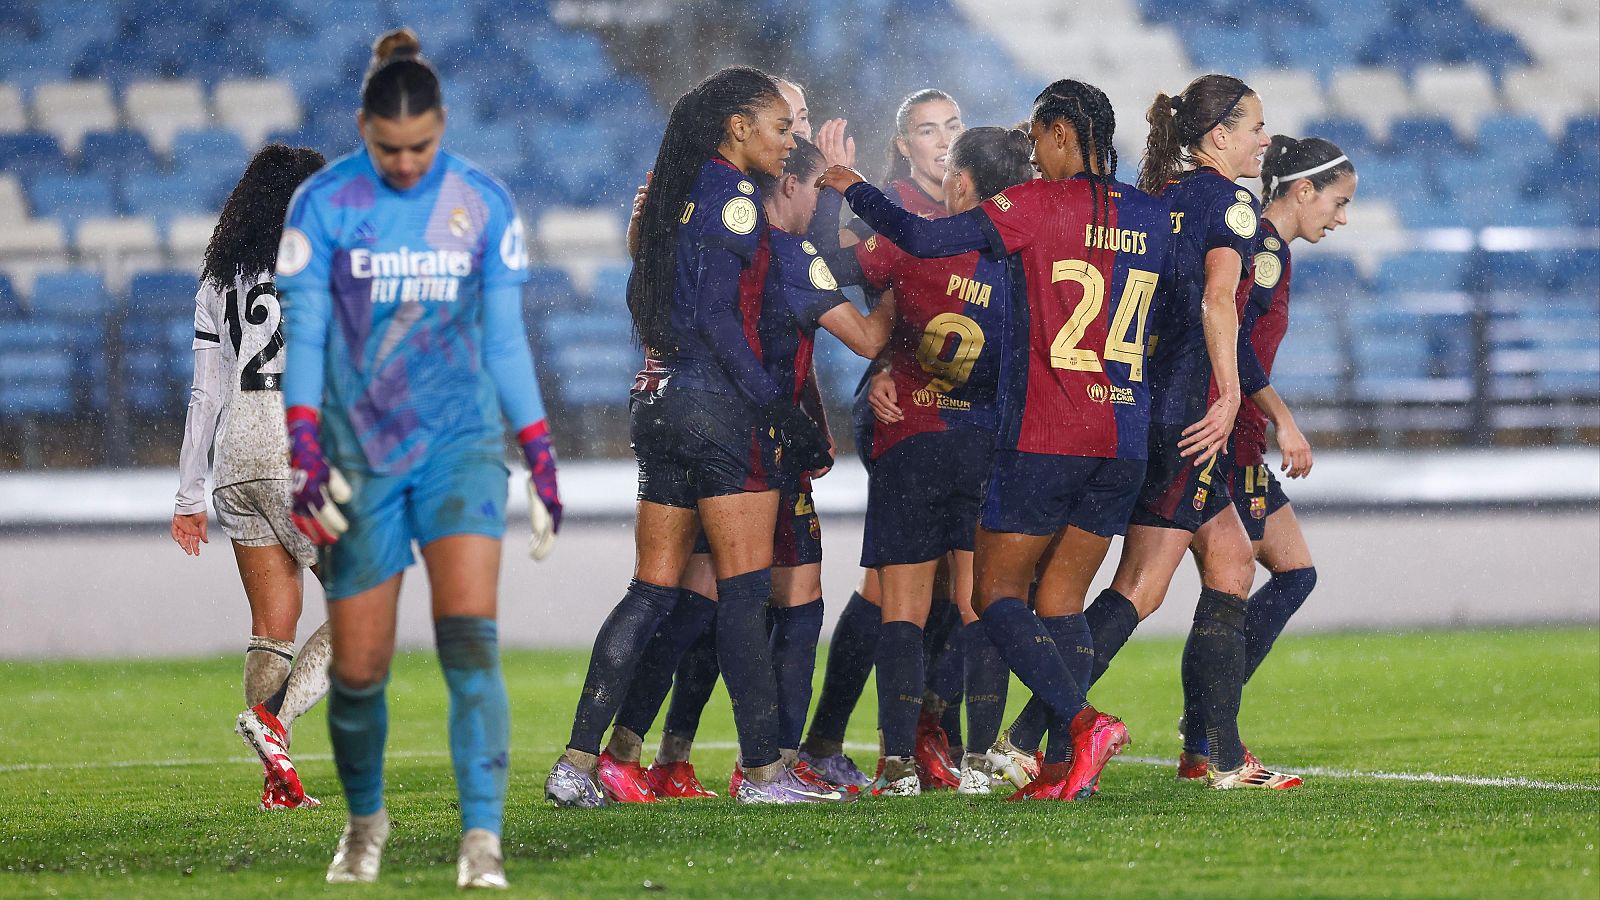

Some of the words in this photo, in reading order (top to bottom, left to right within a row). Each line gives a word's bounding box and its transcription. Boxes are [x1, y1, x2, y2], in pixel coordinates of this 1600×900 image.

[1084, 223, 1147, 255] BRUGTS
[350, 246, 472, 279] Emirates
[946, 274, 992, 308] PINA
[223, 281, 286, 391] 12
[1050, 258, 1159, 383] 24
[915, 312, 986, 392] 9
[936, 398, 971, 408] ACNUR
